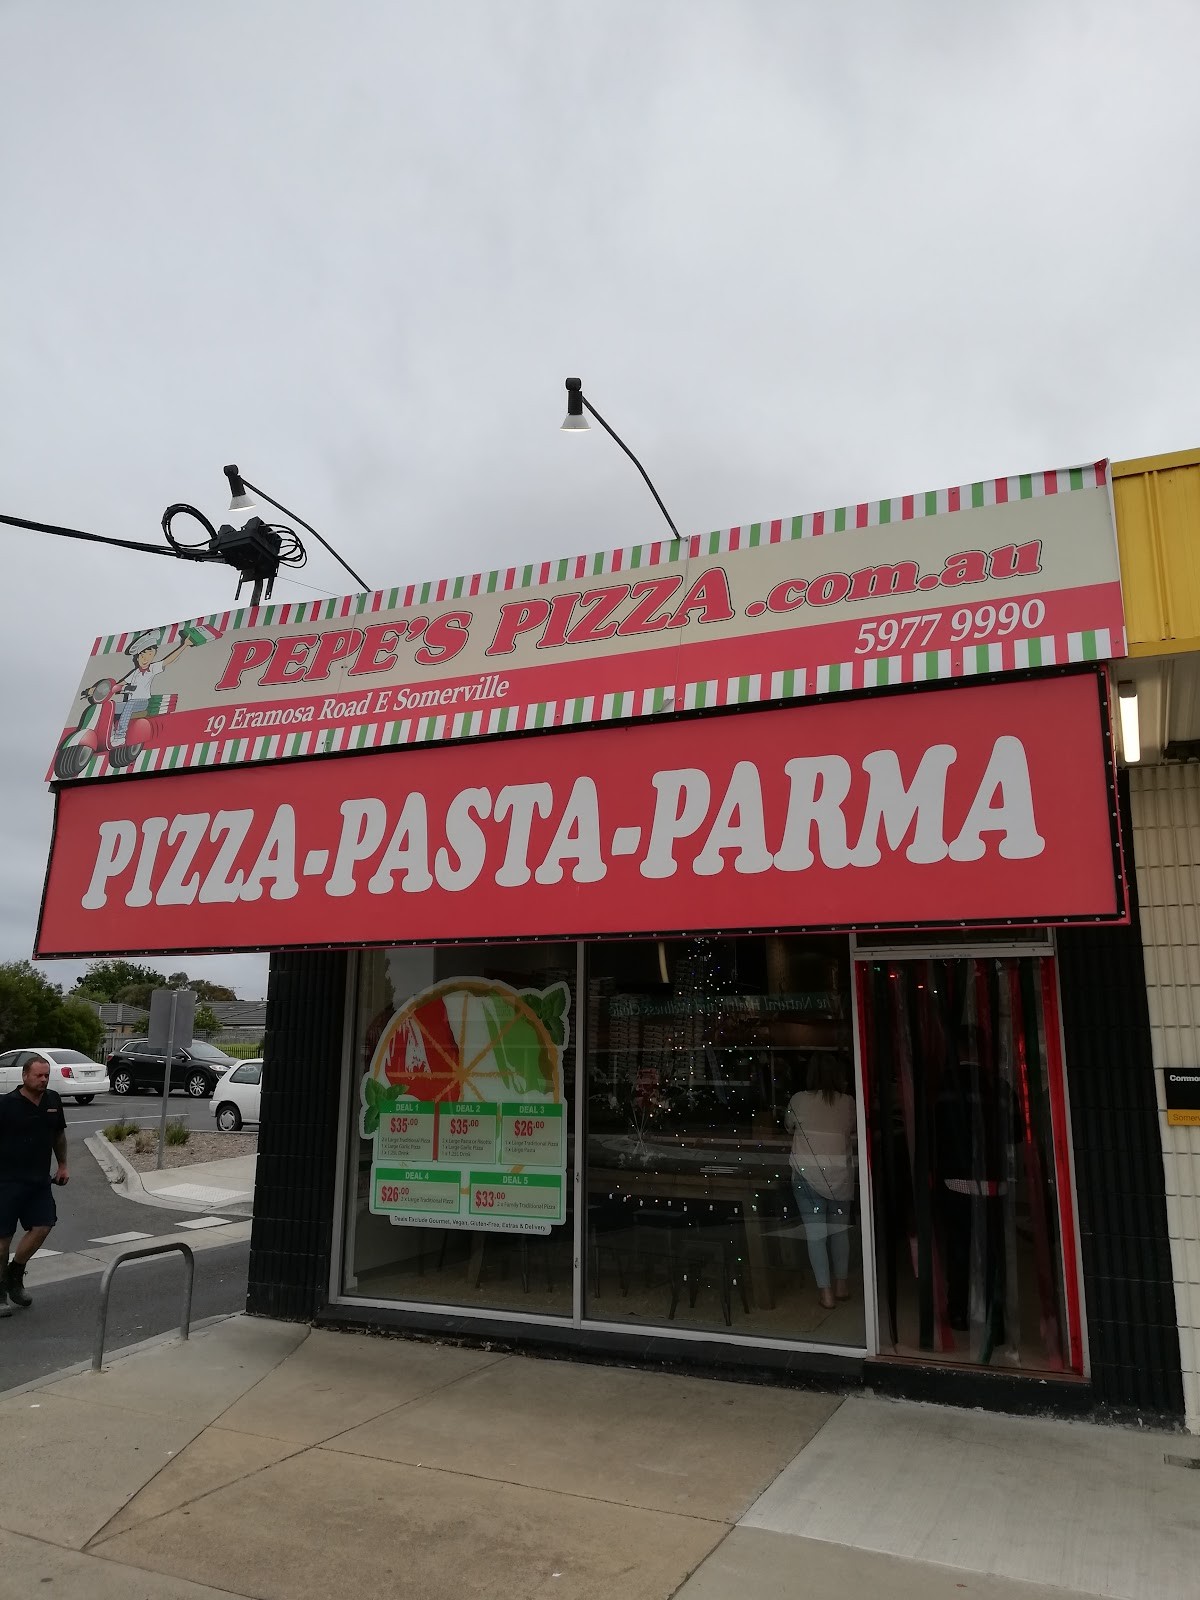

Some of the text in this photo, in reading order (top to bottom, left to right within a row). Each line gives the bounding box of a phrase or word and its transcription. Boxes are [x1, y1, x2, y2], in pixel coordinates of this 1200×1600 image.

[214, 538, 1044, 691] PEPE'S PIZZA .com.au
[854, 598, 1047, 655] 5977 9990
[204, 676, 510, 736] 19 Eramosa Road E Somerville
[396, 1103, 420, 1112] DEAL 1
[455, 1105, 481, 1113] DEAL 2
[519, 1105, 545, 1114] DEAL 3
[390, 1117, 419, 1133] $35.00
[450, 1118, 479, 1135] $35.00
[514, 1119, 545, 1137] $26.00
[405, 1171, 423, 1180] DEAL
[503, 1176, 521, 1184] DEAL
[381, 1186, 410, 1204] $26.00
[476, 1190, 506, 1208] $33.00
[525, 1223, 546, 1232] Delivery
